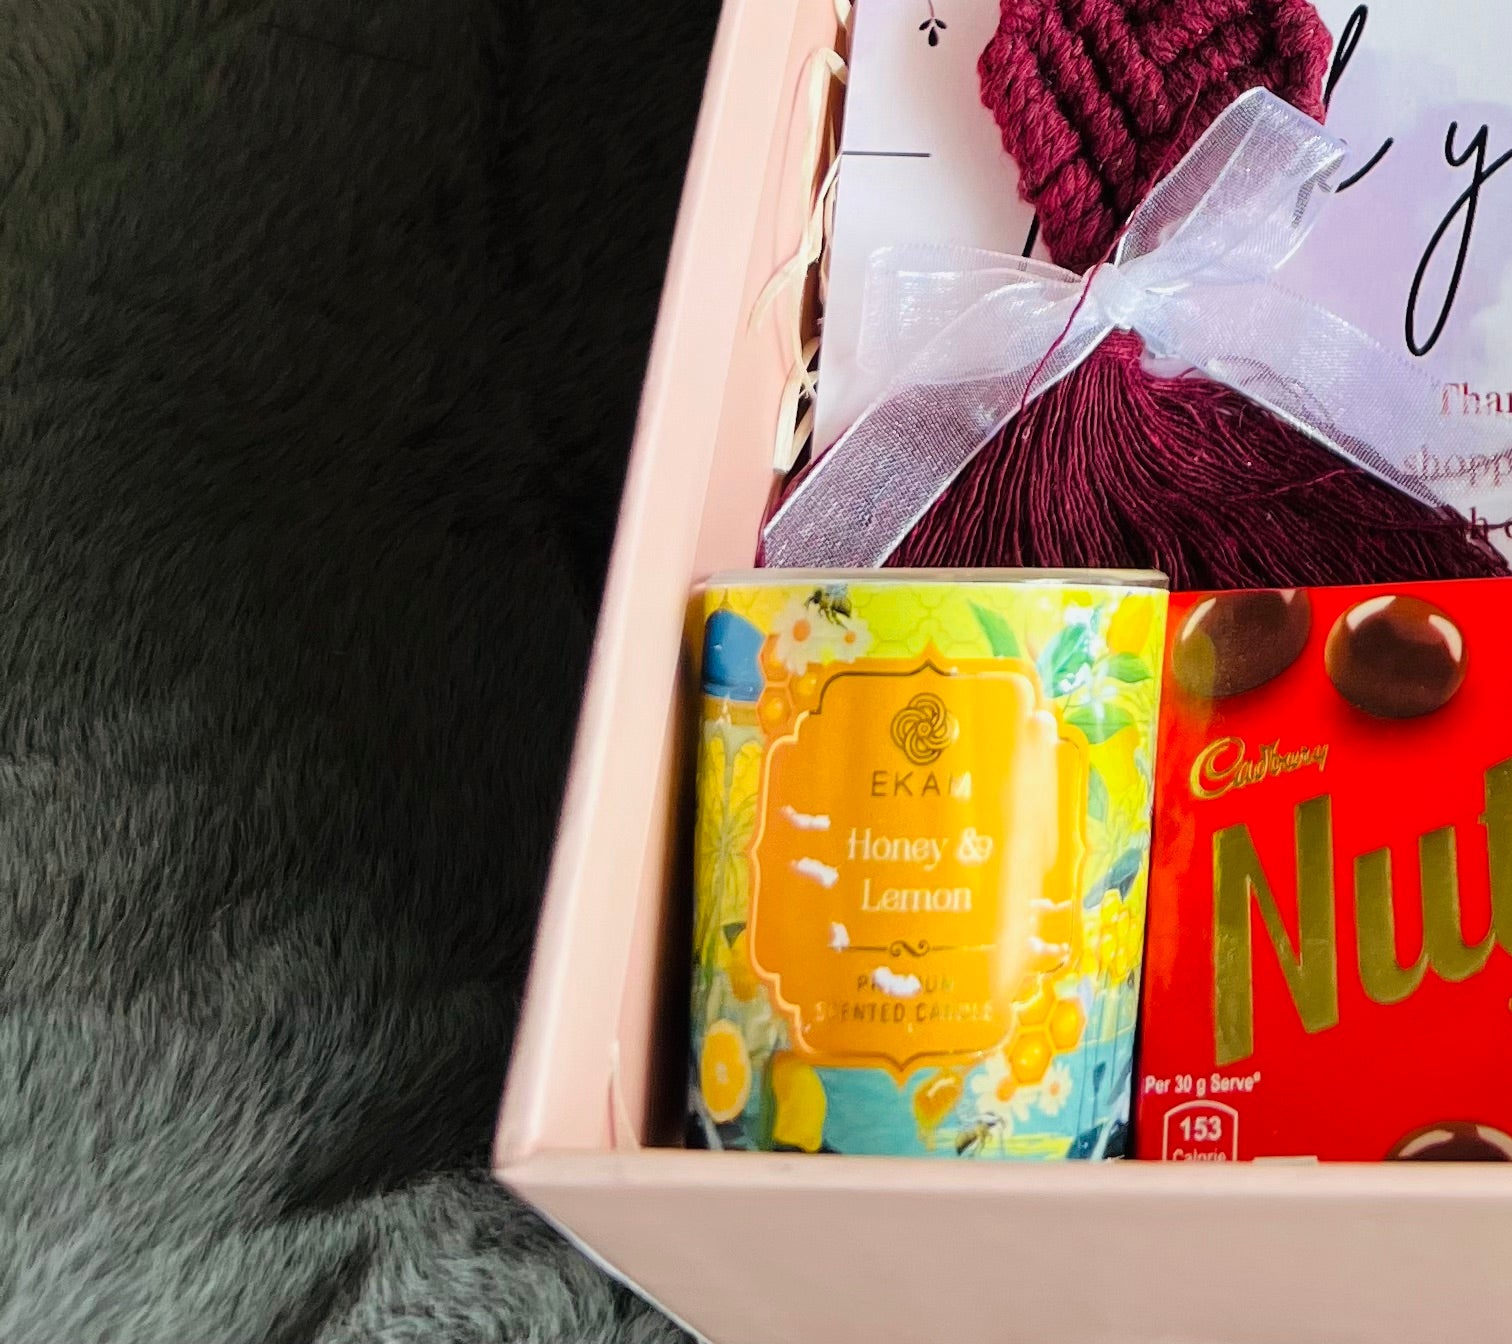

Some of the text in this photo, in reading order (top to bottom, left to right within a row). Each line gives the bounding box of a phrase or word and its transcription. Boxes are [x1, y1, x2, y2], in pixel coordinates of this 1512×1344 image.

[1189, 736, 1330, 800] Cadbury
[847, 826, 994, 872] Honey &
[861, 877, 972, 914] Lemon
[815, 1001, 906, 1023] SENTED
[1144, 1075, 1171, 1094] Per
[1175, 1074, 1192, 1094] 30
[1196, 1078, 1207, 1097] g
[1180, 1115, 1222, 1141] 153
